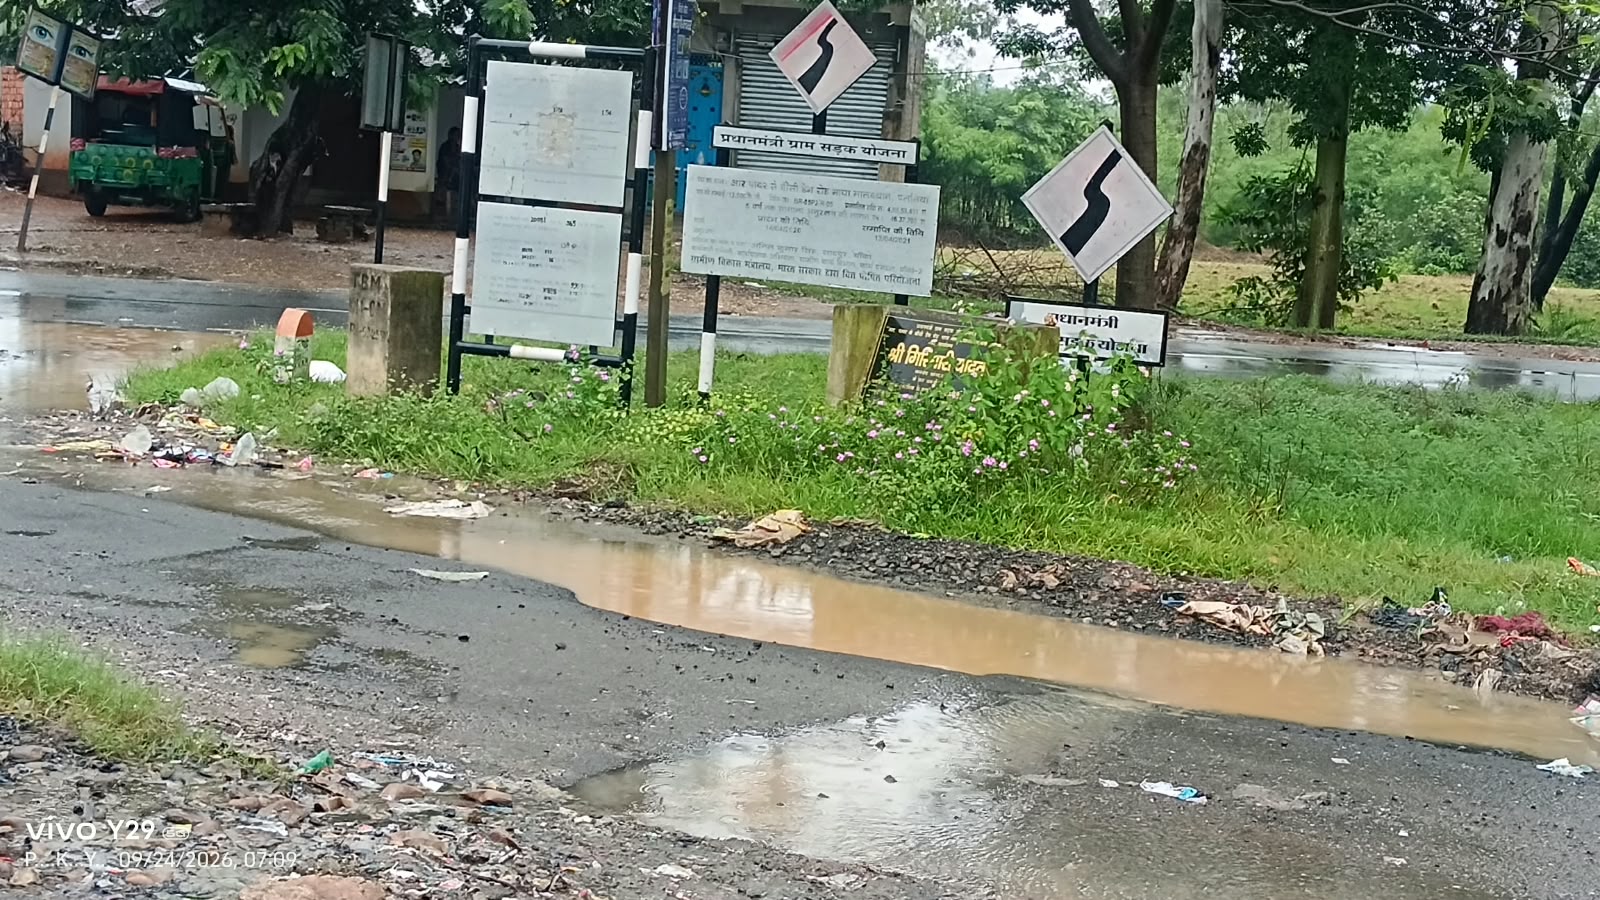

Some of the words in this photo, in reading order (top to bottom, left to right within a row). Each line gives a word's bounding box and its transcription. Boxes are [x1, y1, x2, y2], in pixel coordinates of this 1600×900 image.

[720, 133, 784, 148] प्रधानमंत्री
[788, 140, 816, 151] ग्राम
[820, 143, 858, 155] सड़क
[861, 144, 908, 159] योजना
